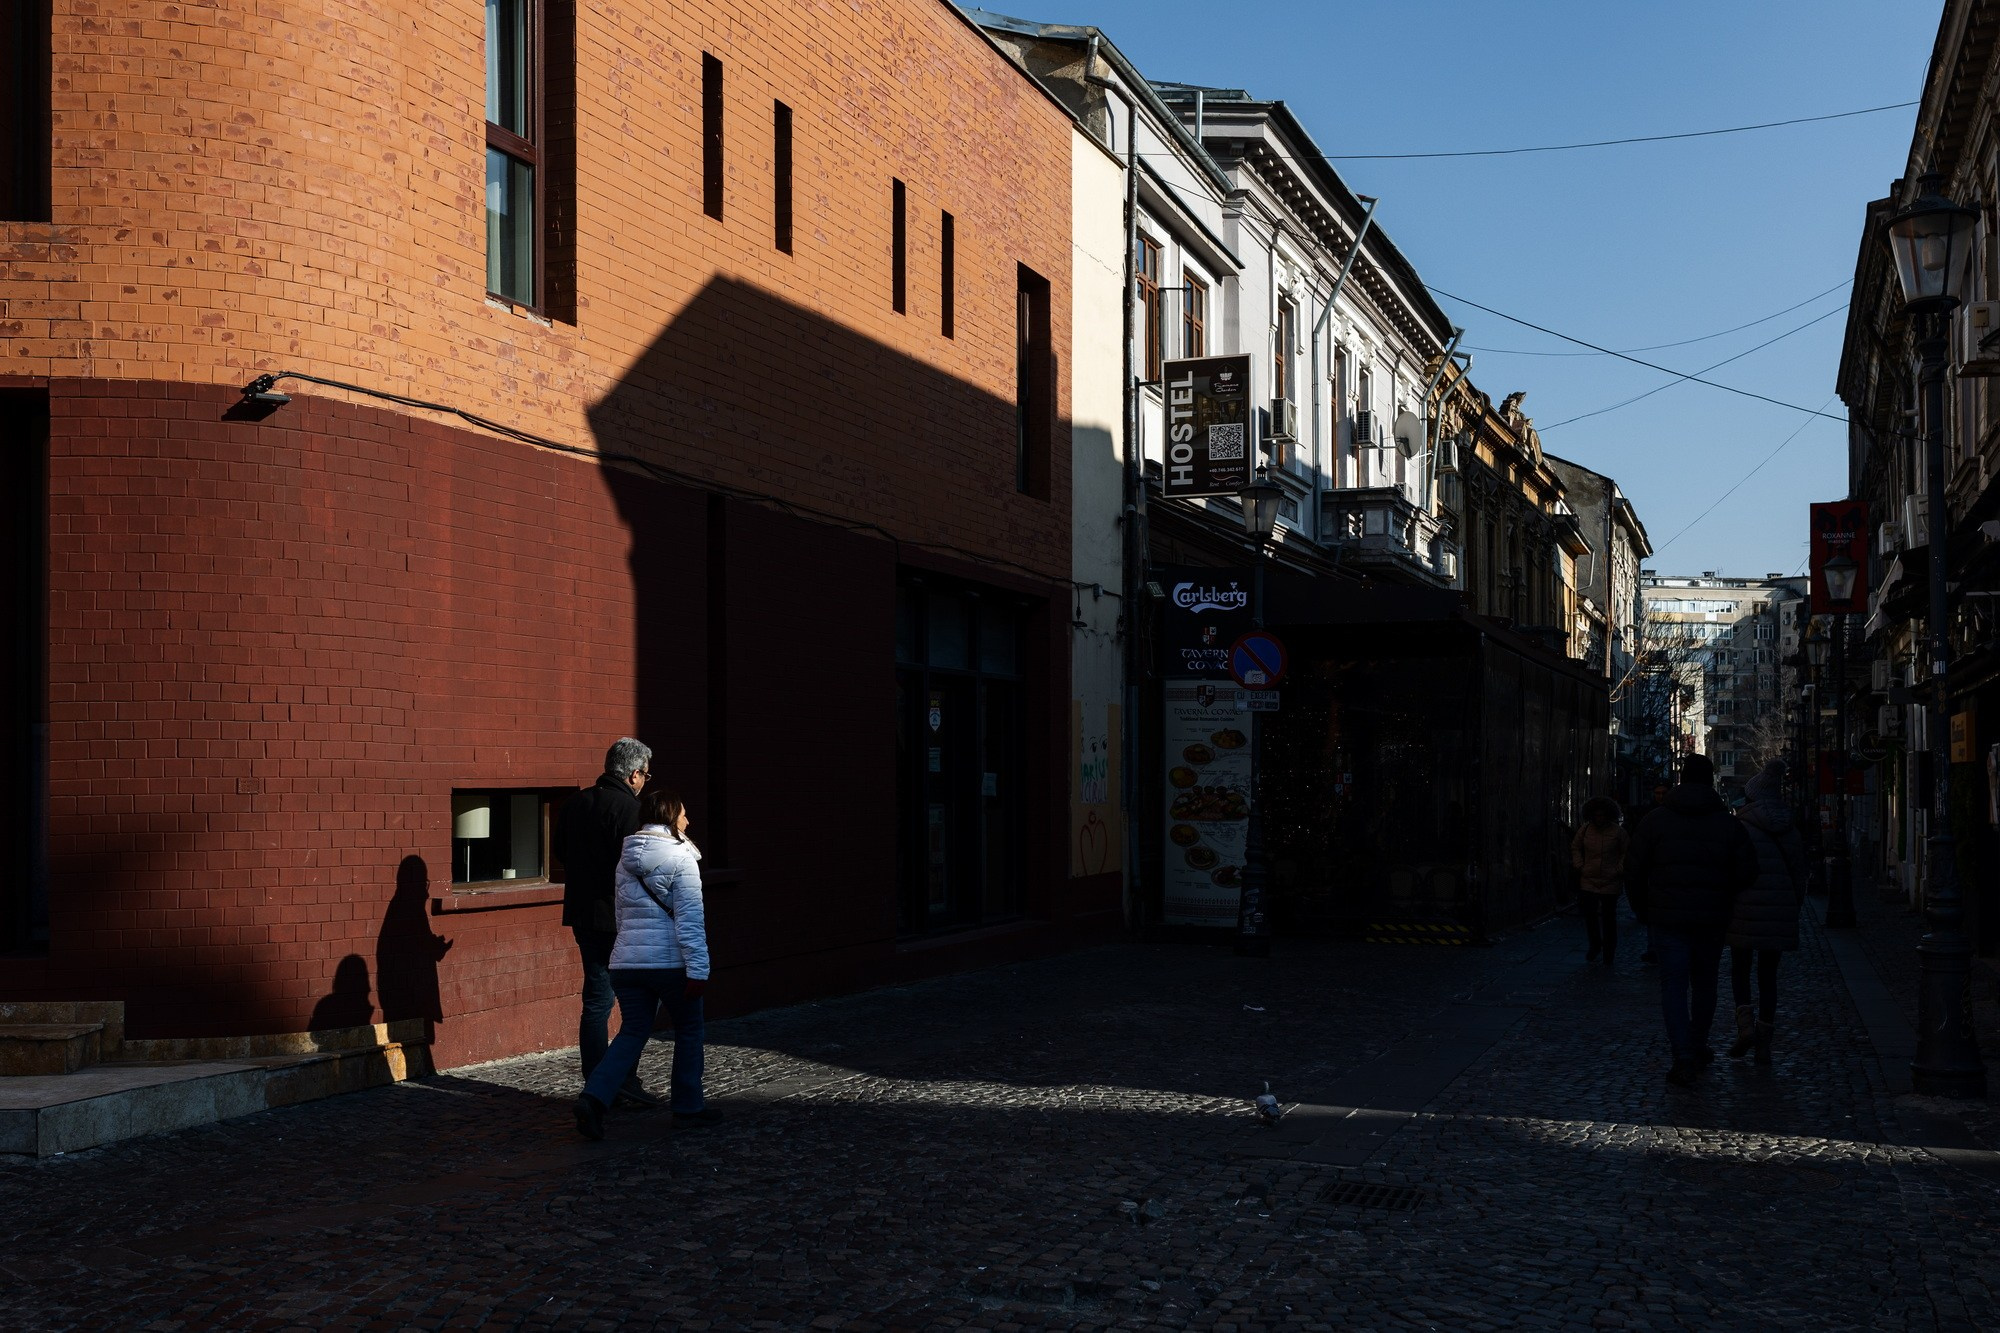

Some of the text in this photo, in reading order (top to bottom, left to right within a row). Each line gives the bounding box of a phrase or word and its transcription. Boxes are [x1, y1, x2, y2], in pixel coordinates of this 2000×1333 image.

[1170, 370, 1194, 486] HOSTEL
[1822, 531, 1856, 540] ROXANNE
[1172, 581, 1247, 613] Carlsberg
[1180, 648, 1229, 660] TAVERN
[1187, 660, 1229, 671] COVAC
[1236, 691, 1245, 700] CU
[1174, 708, 1208, 716] TAVERNA
